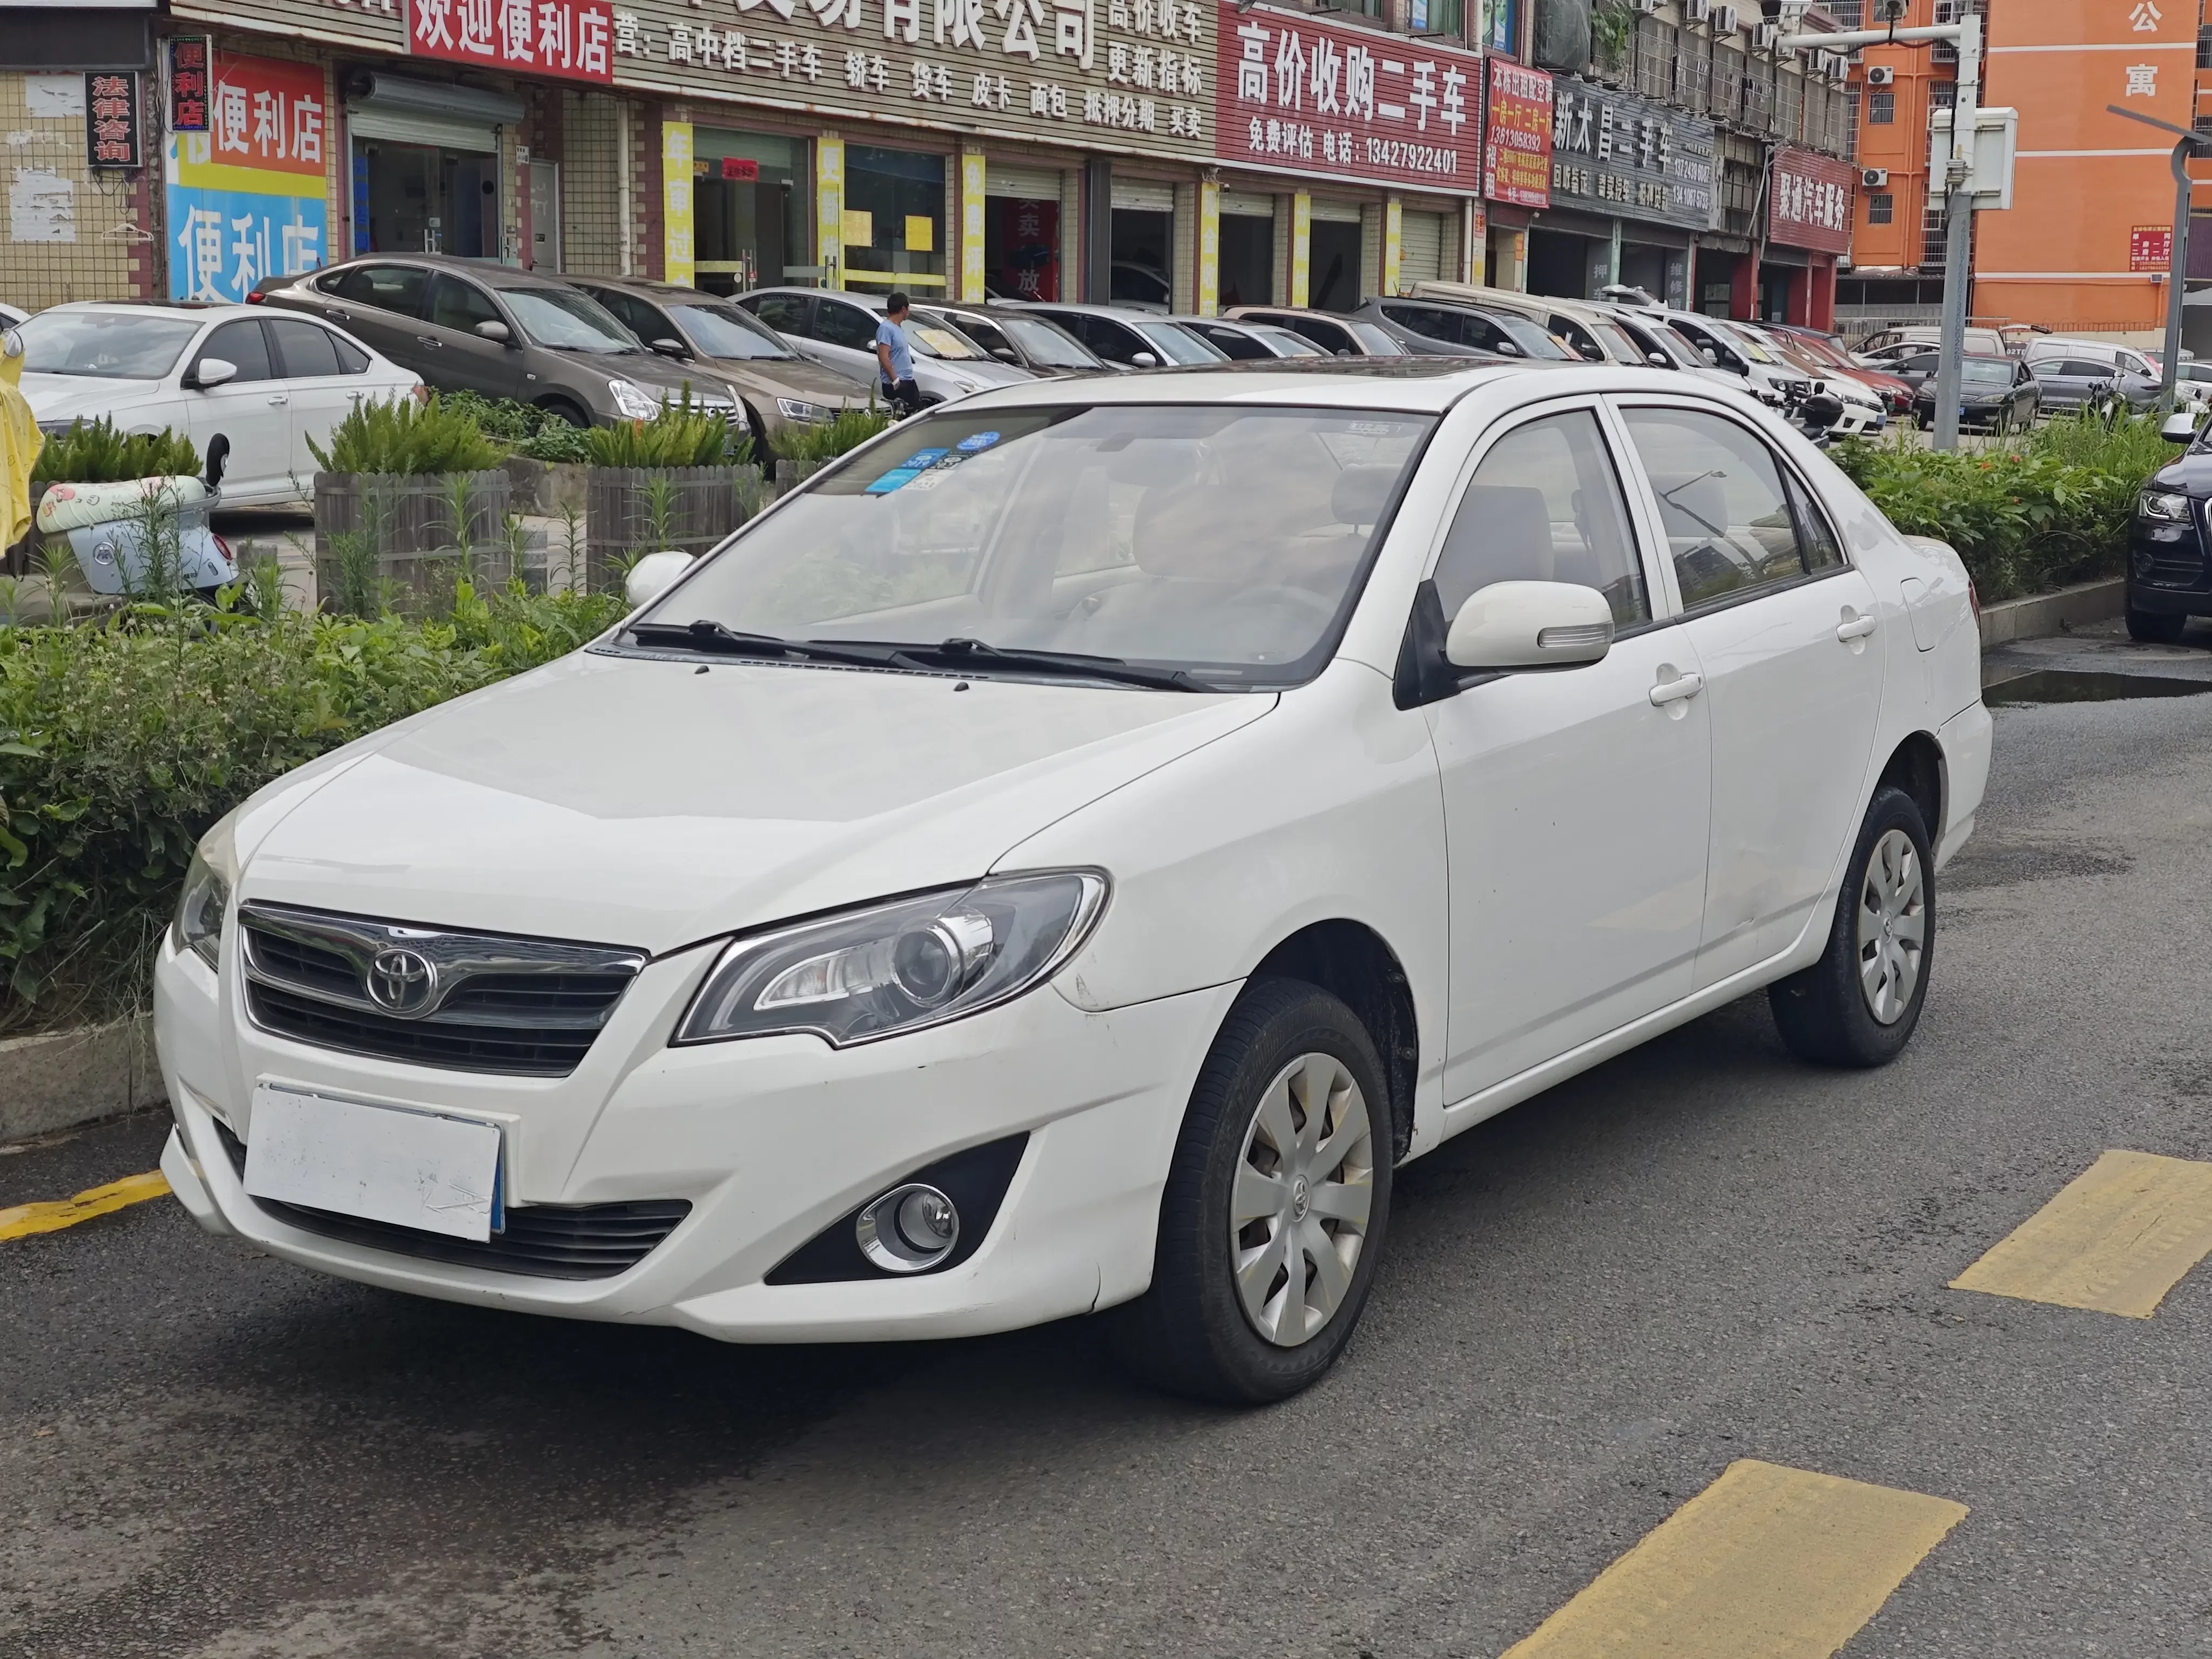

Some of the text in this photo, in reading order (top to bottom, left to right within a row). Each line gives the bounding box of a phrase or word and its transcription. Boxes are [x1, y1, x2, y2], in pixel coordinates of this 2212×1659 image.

[416, 0, 608, 75] 欢迎便利店
[688, 0, 1095, 70] 有限公司
[1108, 0, 1202, 44] 高价收车
[2126, 2, 2162, 97] 公寓
[174, 42, 204, 126] 便利店
[667, 22, 822, 81] 高中档二手车
[844, 50, 890, 92] 轿车
[910, 60, 953, 102] 货车
[972, 72, 1013, 110] 皮卡
[1029, 80, 1068, 118] 面包
[1083, 90, 1155, 132] 抵押分期
[1168, 106, 1202, 139] 买卖
[1107, 41, 1203, 96] 更新指标
[1237, 22, 1467, 136] 高价收购二手车
[92, 76, 131, 162] 法律咨询
[213, 79, 322, 164] 便利店
[1248, 116, 1314, 159] 免费评估
[1490, 125, 1541, 151] 13613058392
[1492, 100, 1521, 128] 一房一厅
[1554, 90, 1674, 173] 新太昌二手车
[1779, 172, 1845, 231] 聚通汽车服务
